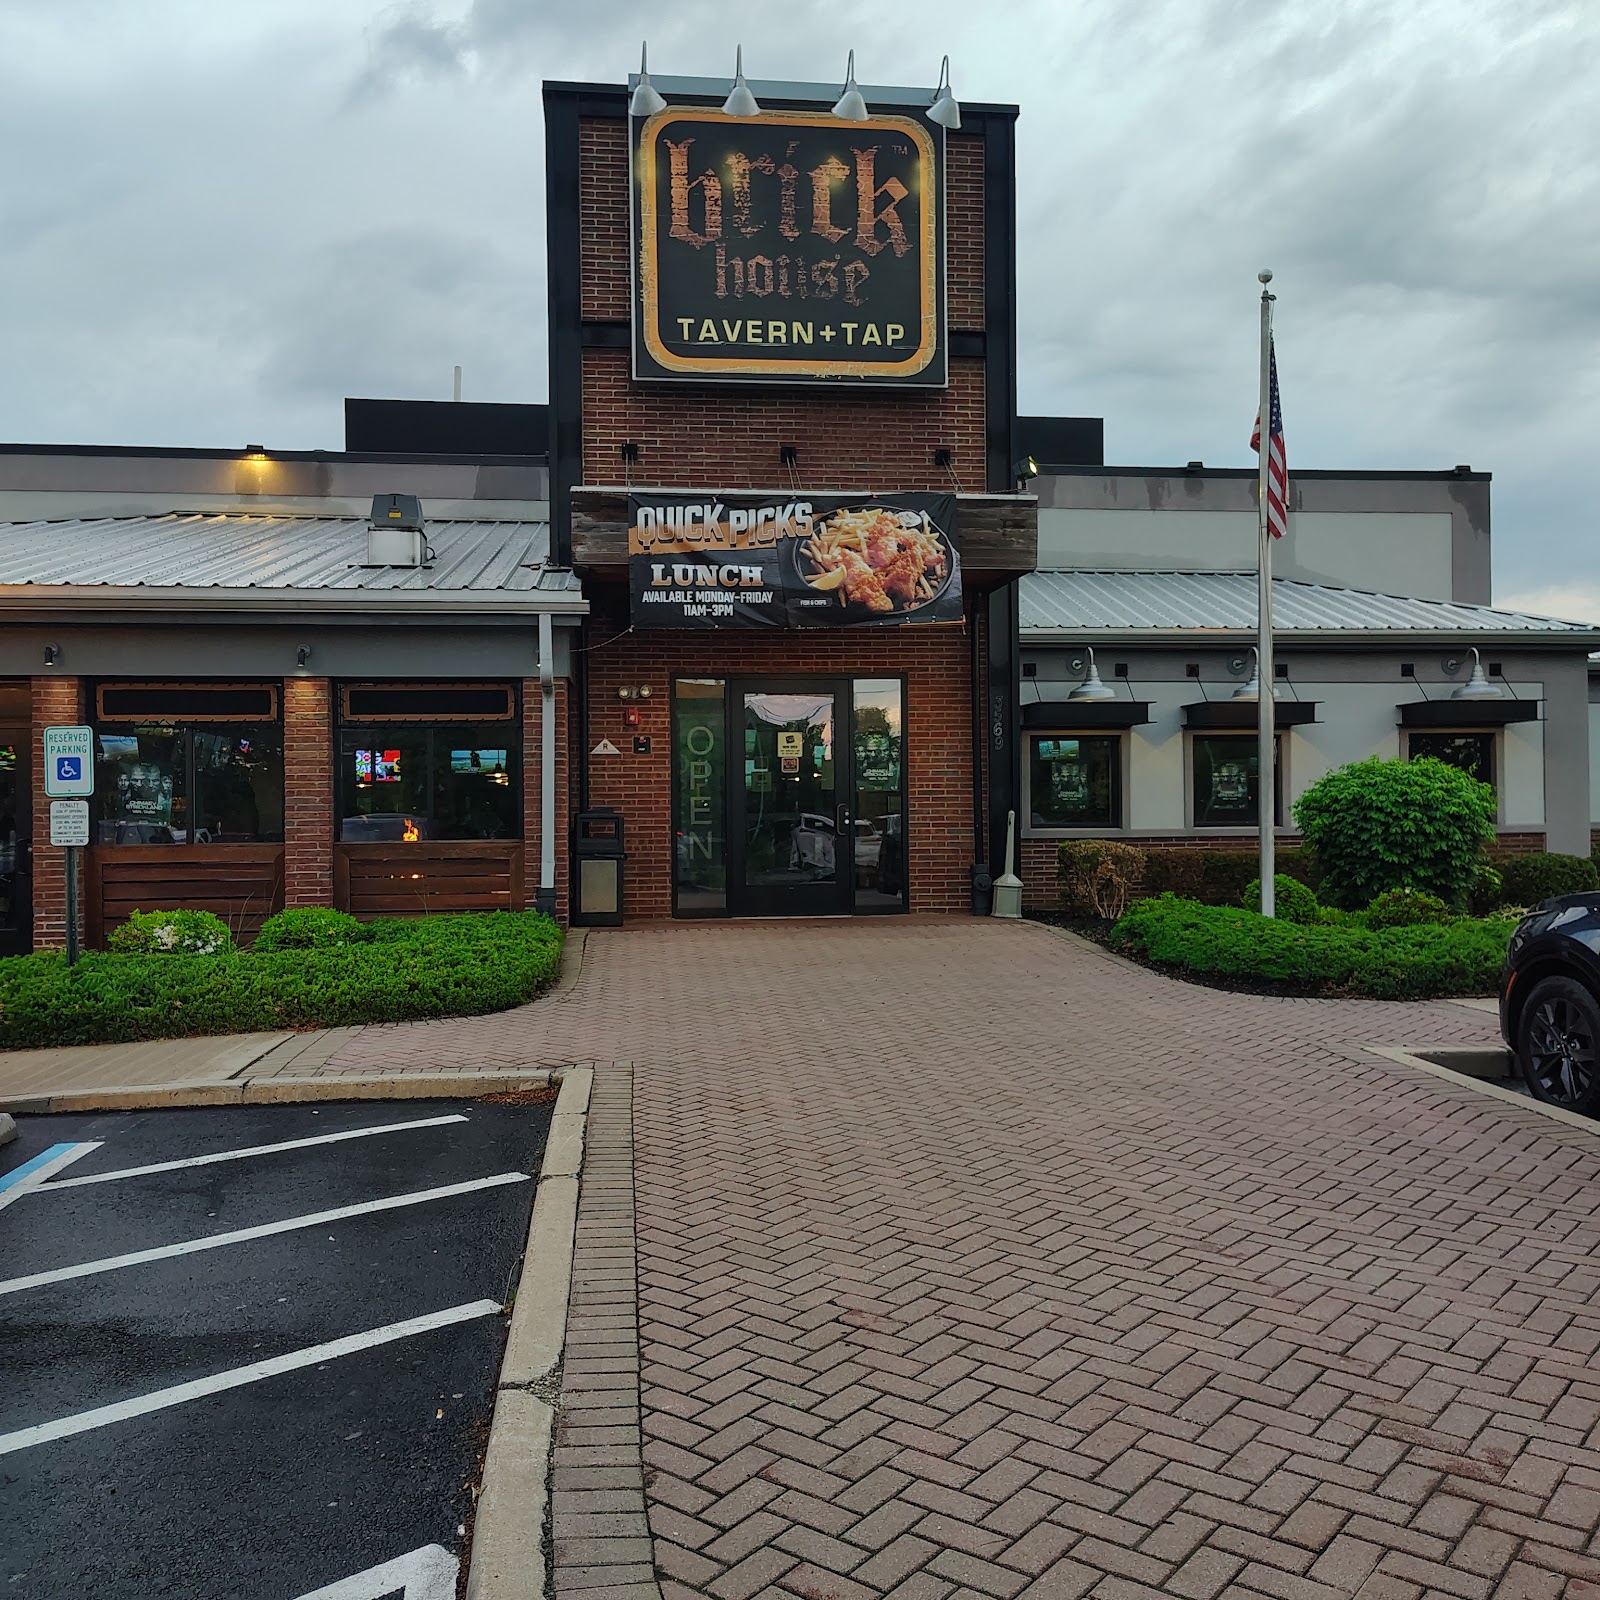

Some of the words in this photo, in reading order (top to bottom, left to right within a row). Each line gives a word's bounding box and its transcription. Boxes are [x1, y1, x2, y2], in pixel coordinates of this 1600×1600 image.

[663, 136, 913, 257] brick
[713, 242, 870, 307] house
[637, 503, 724, 547] QUICK
[728, 502, 814, 547] PICKS
[651, 563, 764, 588] LUNCH
[642, 591, 693, 604] AVAILABLE
[695, 591, 773, 604] MONDAY-FRIDAY
[683, 604, 733, 617] 11AM-3PM
[49, 733, 88, 743] RESERVED
[50, 745, 87, 754] PARKING
[687, 726, 715, 860] OPEN
